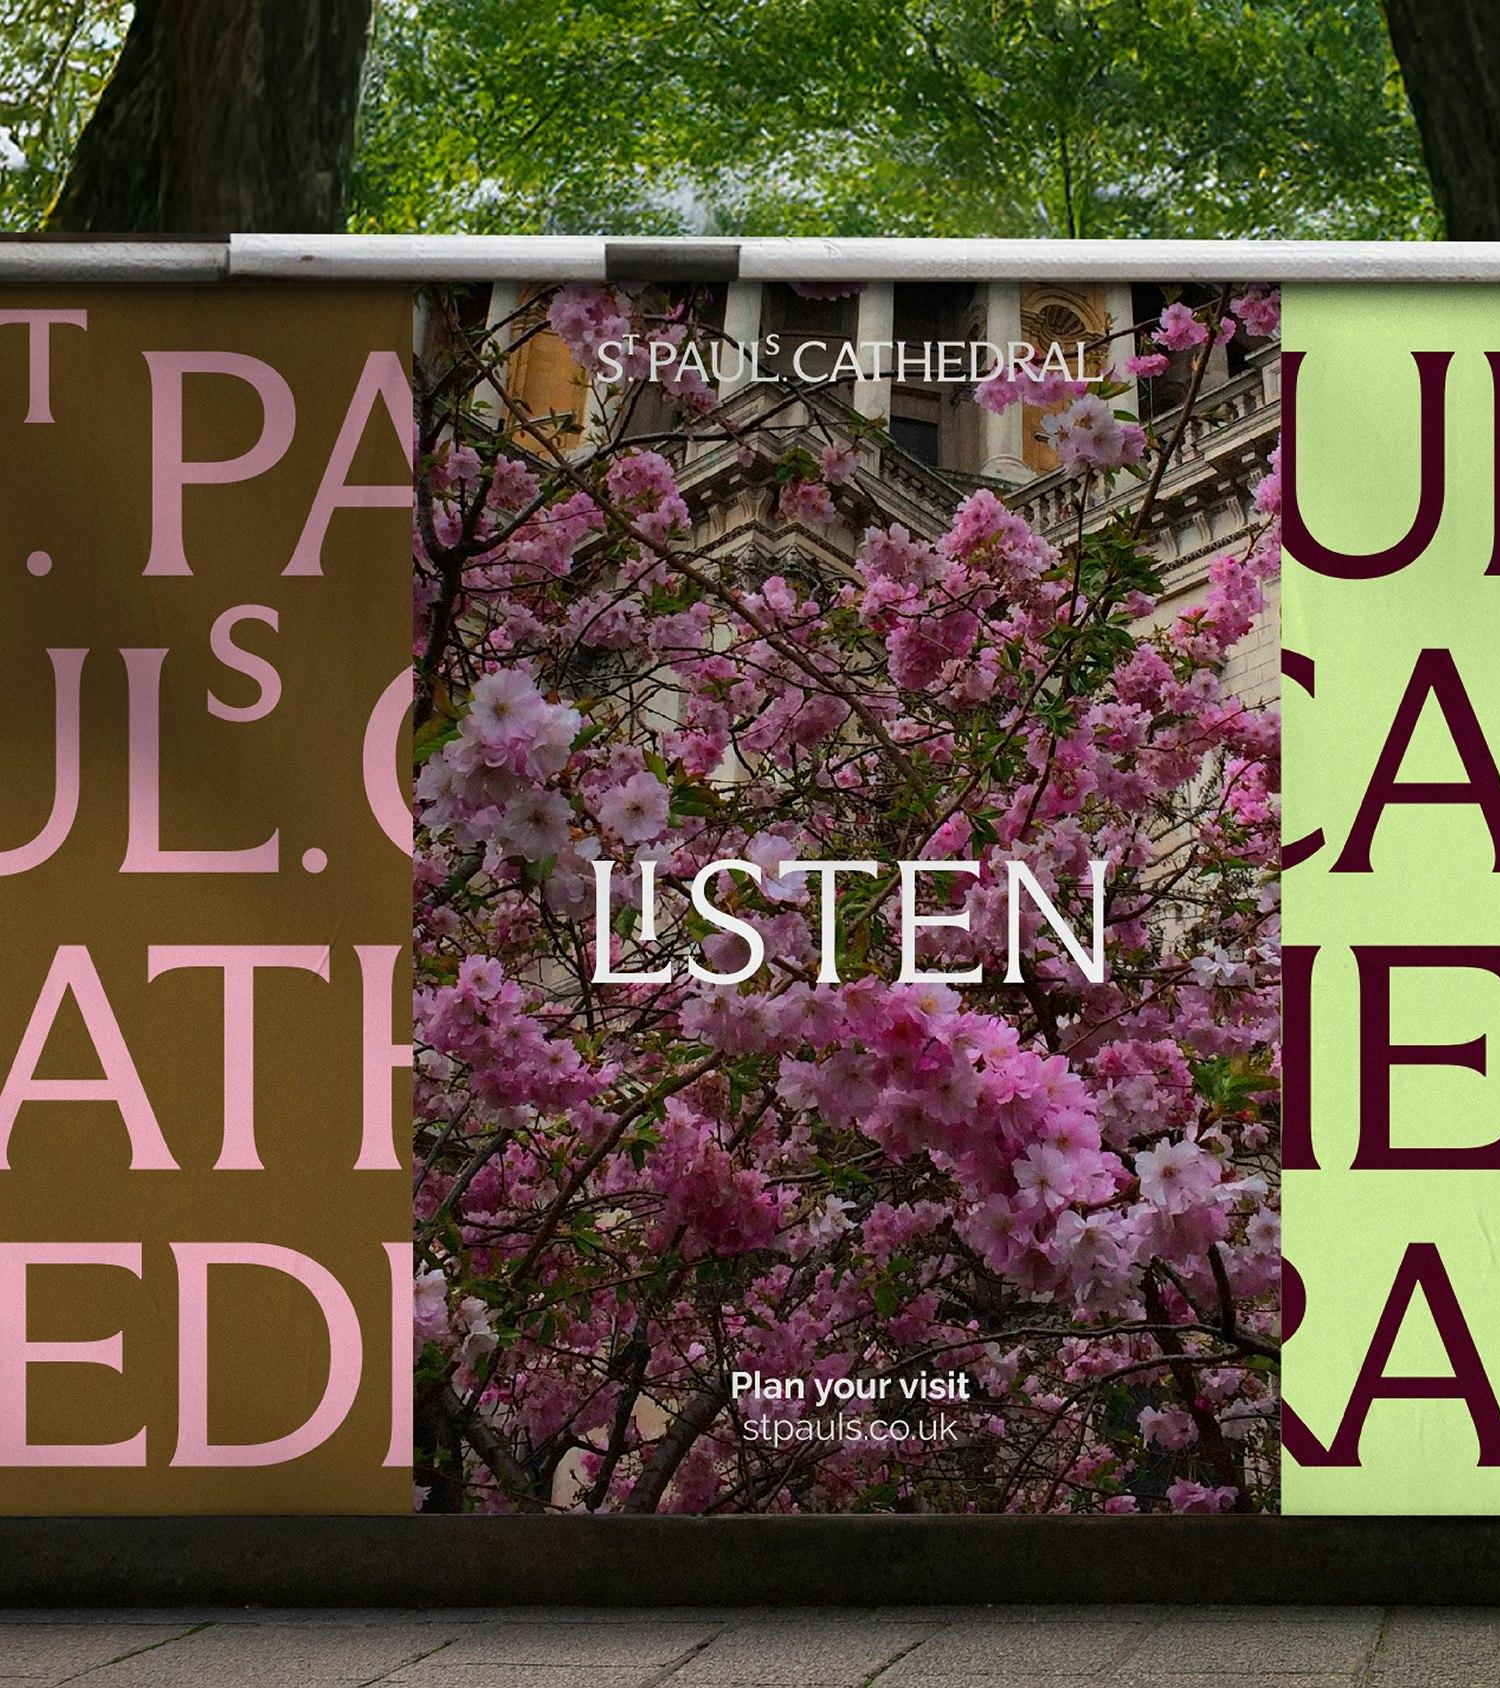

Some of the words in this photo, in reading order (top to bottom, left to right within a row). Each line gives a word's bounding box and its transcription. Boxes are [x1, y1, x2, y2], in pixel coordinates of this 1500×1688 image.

[793, 340, 1104, 383] CATHEDRAL
[590, 858, 1111, 985] LISTEN
[0, 1241, 412, 1468] ED
[731, 1370, 804, 1399] Plan
[814, 1378, 892, 1407] your
[899, 1370, 970, 1400] visit
[743, 1412, 959, 1448] stpauls.co.uk
